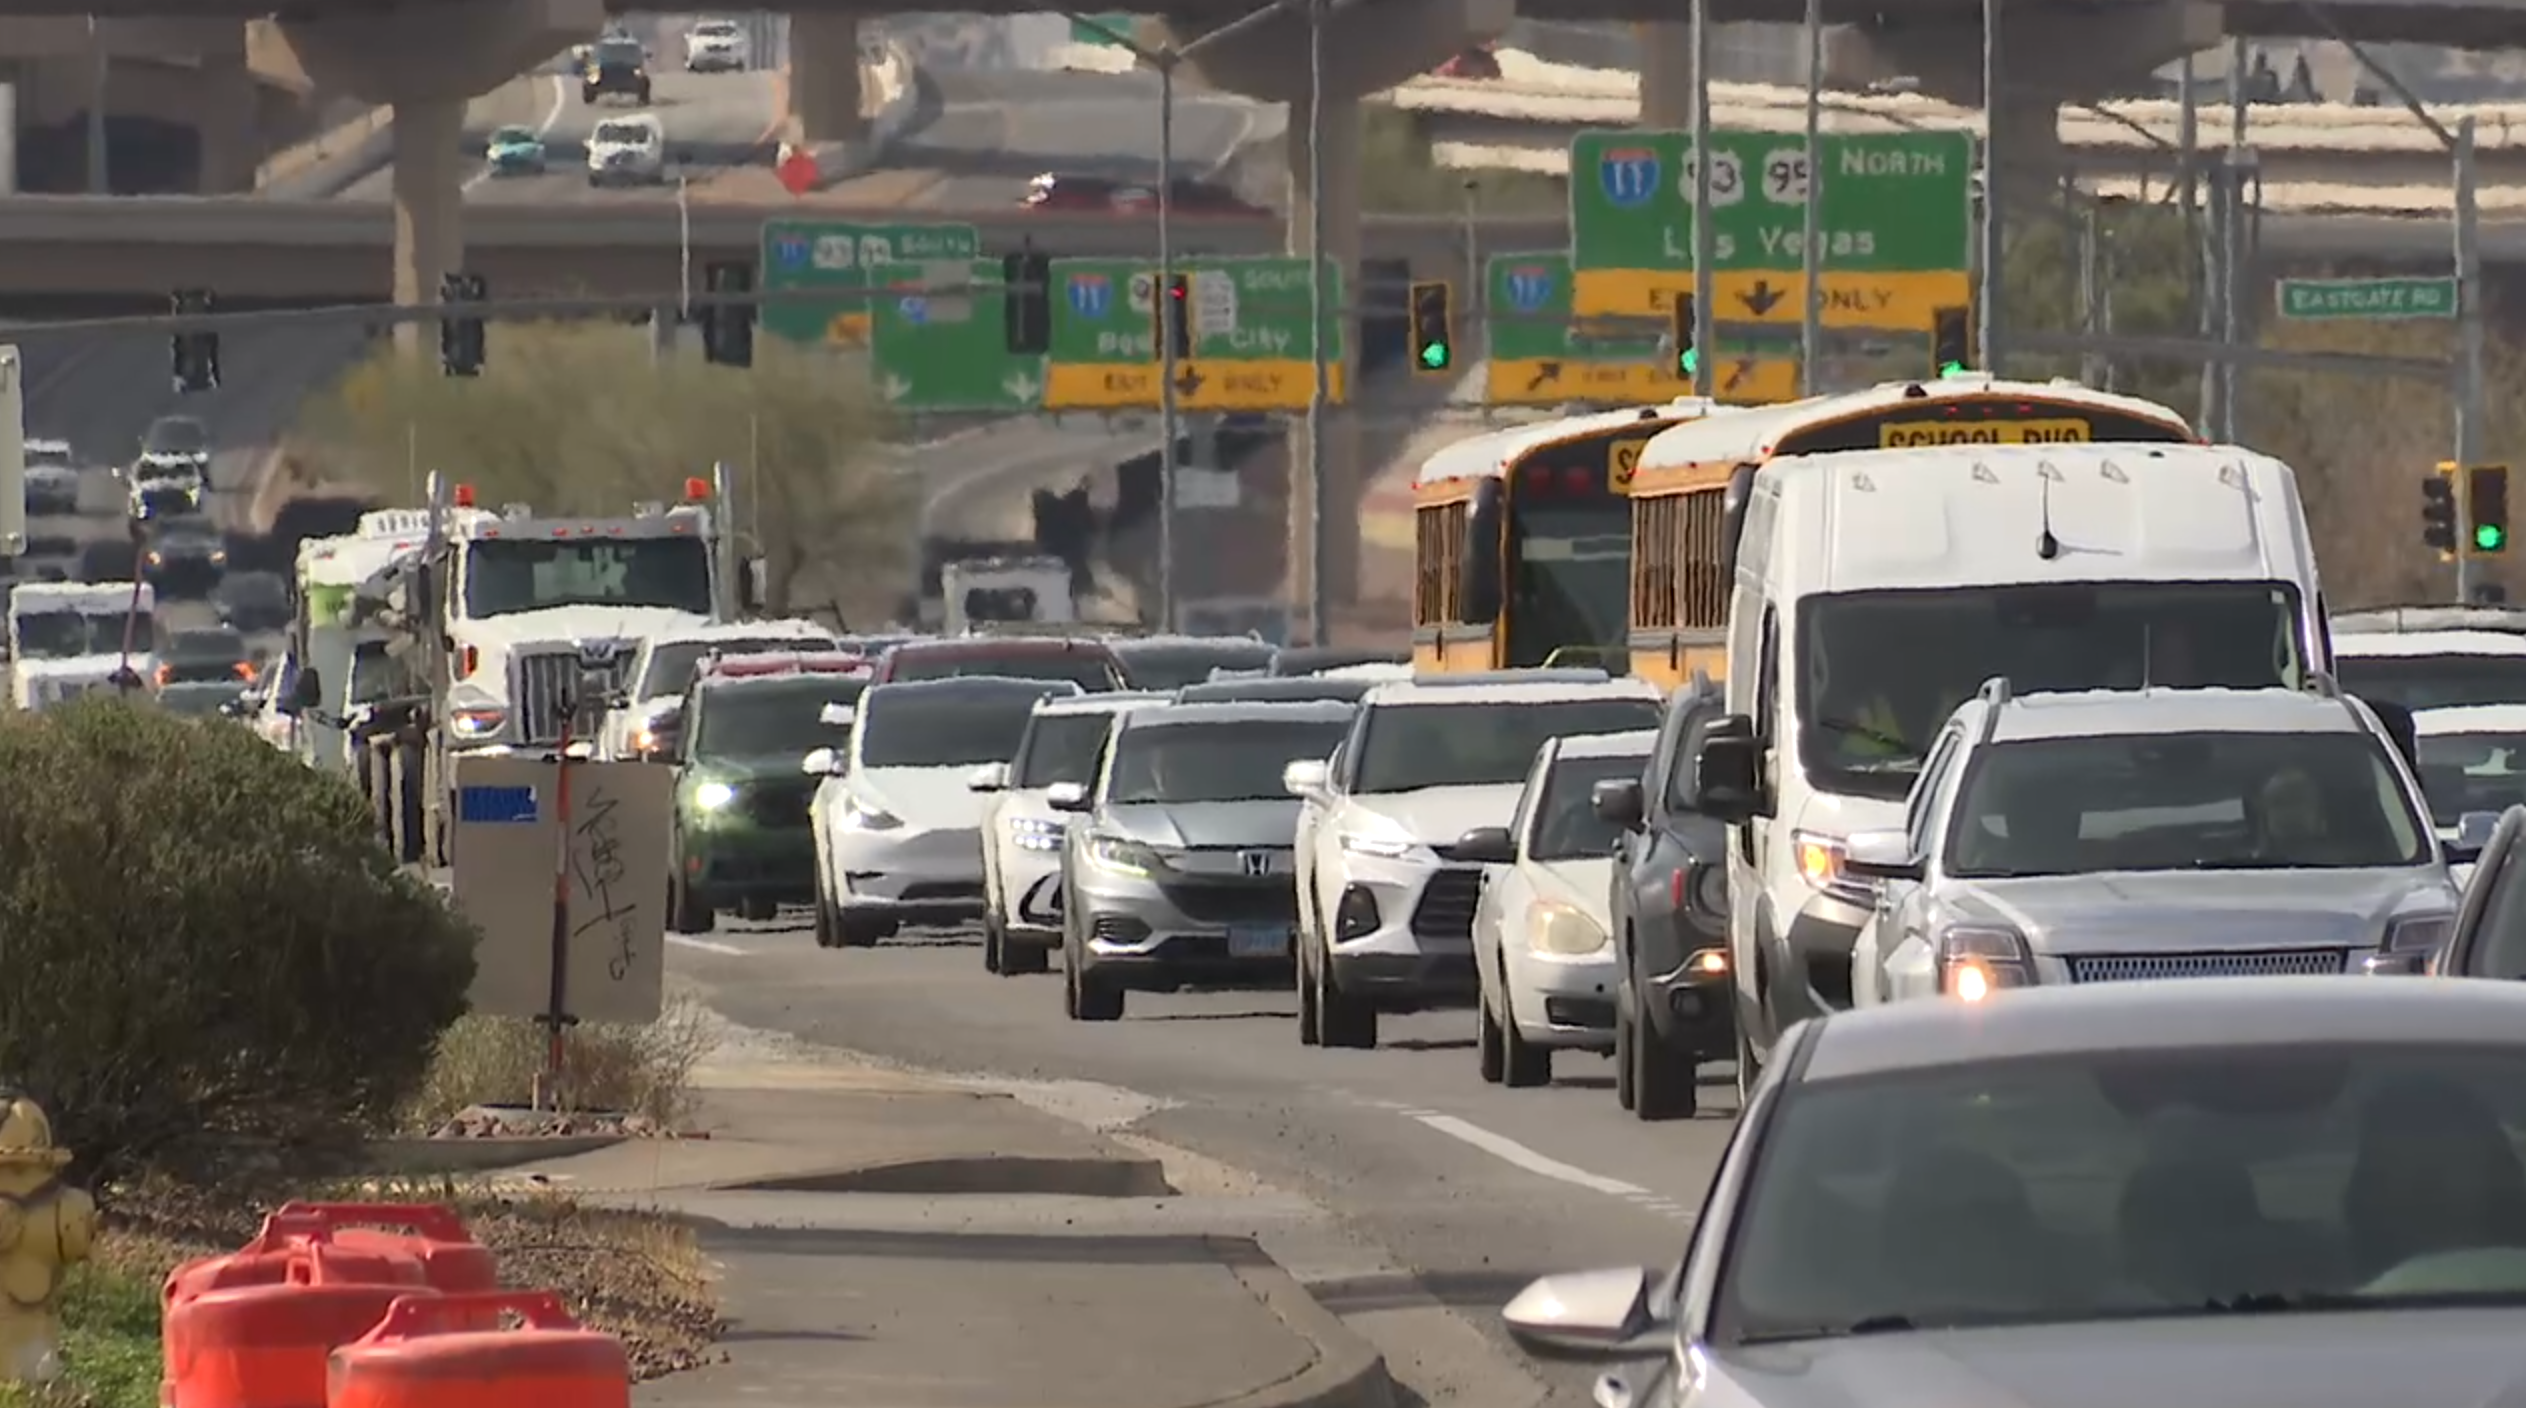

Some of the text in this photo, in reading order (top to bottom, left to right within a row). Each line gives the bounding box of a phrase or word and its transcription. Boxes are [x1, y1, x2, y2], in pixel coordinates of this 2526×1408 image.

[1840, 147, 1946, 177] NORTH
[1663, 227, 1735, 260] Ls
[2291, 287, 2441, 309] EASTGATE RD
